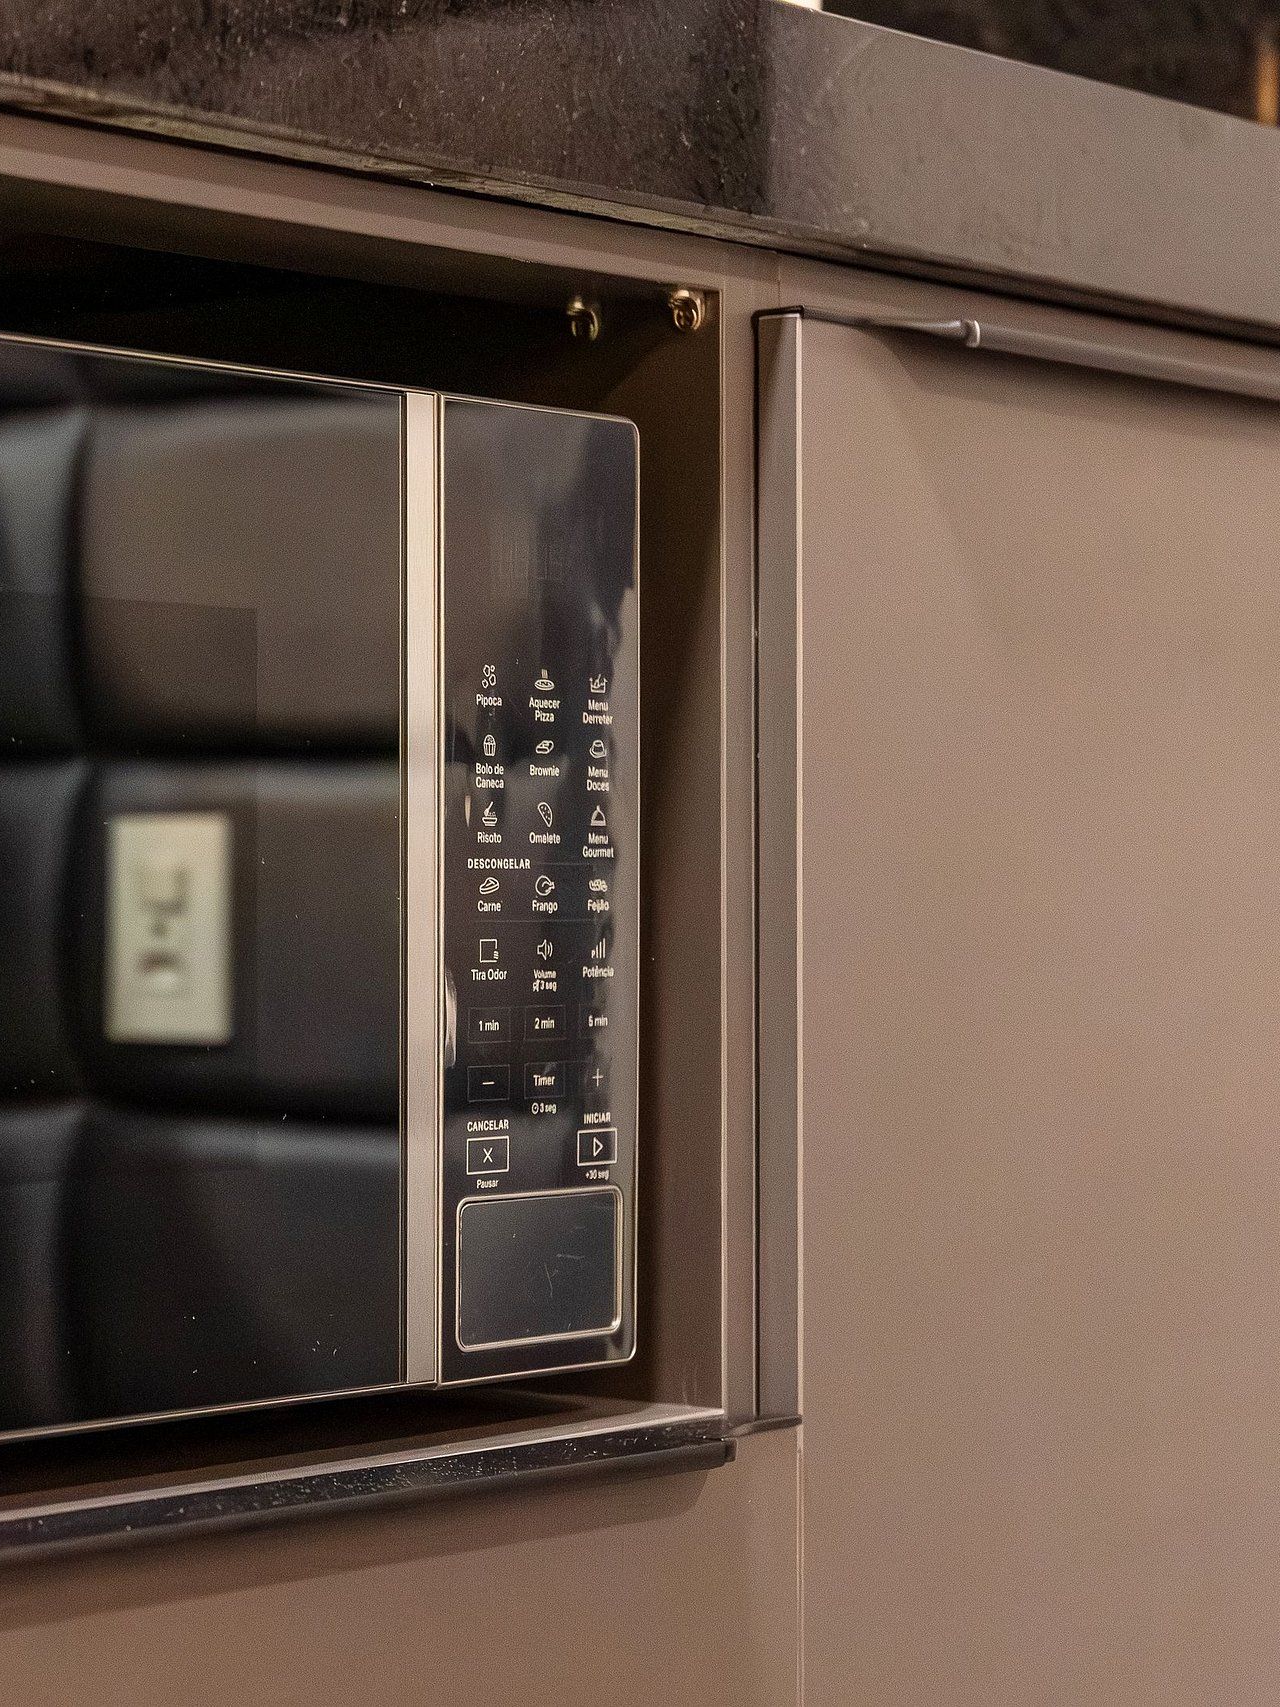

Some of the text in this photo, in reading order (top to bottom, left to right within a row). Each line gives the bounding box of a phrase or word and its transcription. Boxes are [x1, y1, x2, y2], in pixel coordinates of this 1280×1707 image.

[476, 694, 502, 708] Pipoca
[529, 697, 560, 709] Aquecer
[588, 700, 609, 711] Menu
[535, 710, 554, 722] Pizza
[582, 713, 613, 725] Derreter
[476, 763, 504, 775] Bolo de
[529, 765, 559, 776] Brownie
[588, 766, 608, 778] Menu
[476, 777, 504, 788] Caneca
[587, 779, 609, 791] Doces
[477, 832, 502, 844] Risoto
[529, 832, 560, 844] Omelete
[588, 833, 609, 844] Menu
[583, 846, 614, 858] Gourmet
[468, 859, 531, 869] DESCONGELAR
[478, 901, 501, 912] Carne
[532, 900, 558, 914] Frango
[471, 969, 507, 981] Tira Odor
[534, 970, 556, 979] Volume
[479, 1020, 499, 1031] 1 min
[535, 1018, 554, 1029] 2 min
[595, 1015, 608, 1026] min
[534, 1075, 555, 1086] Timer
[540, 1104, 557, 1114] 3 seg
[584, 1112, 611, 1124] INICIAR
[467, 1119, 509, 1132] CANCELAR
[477, 1180, 499, 1188] Pausar
